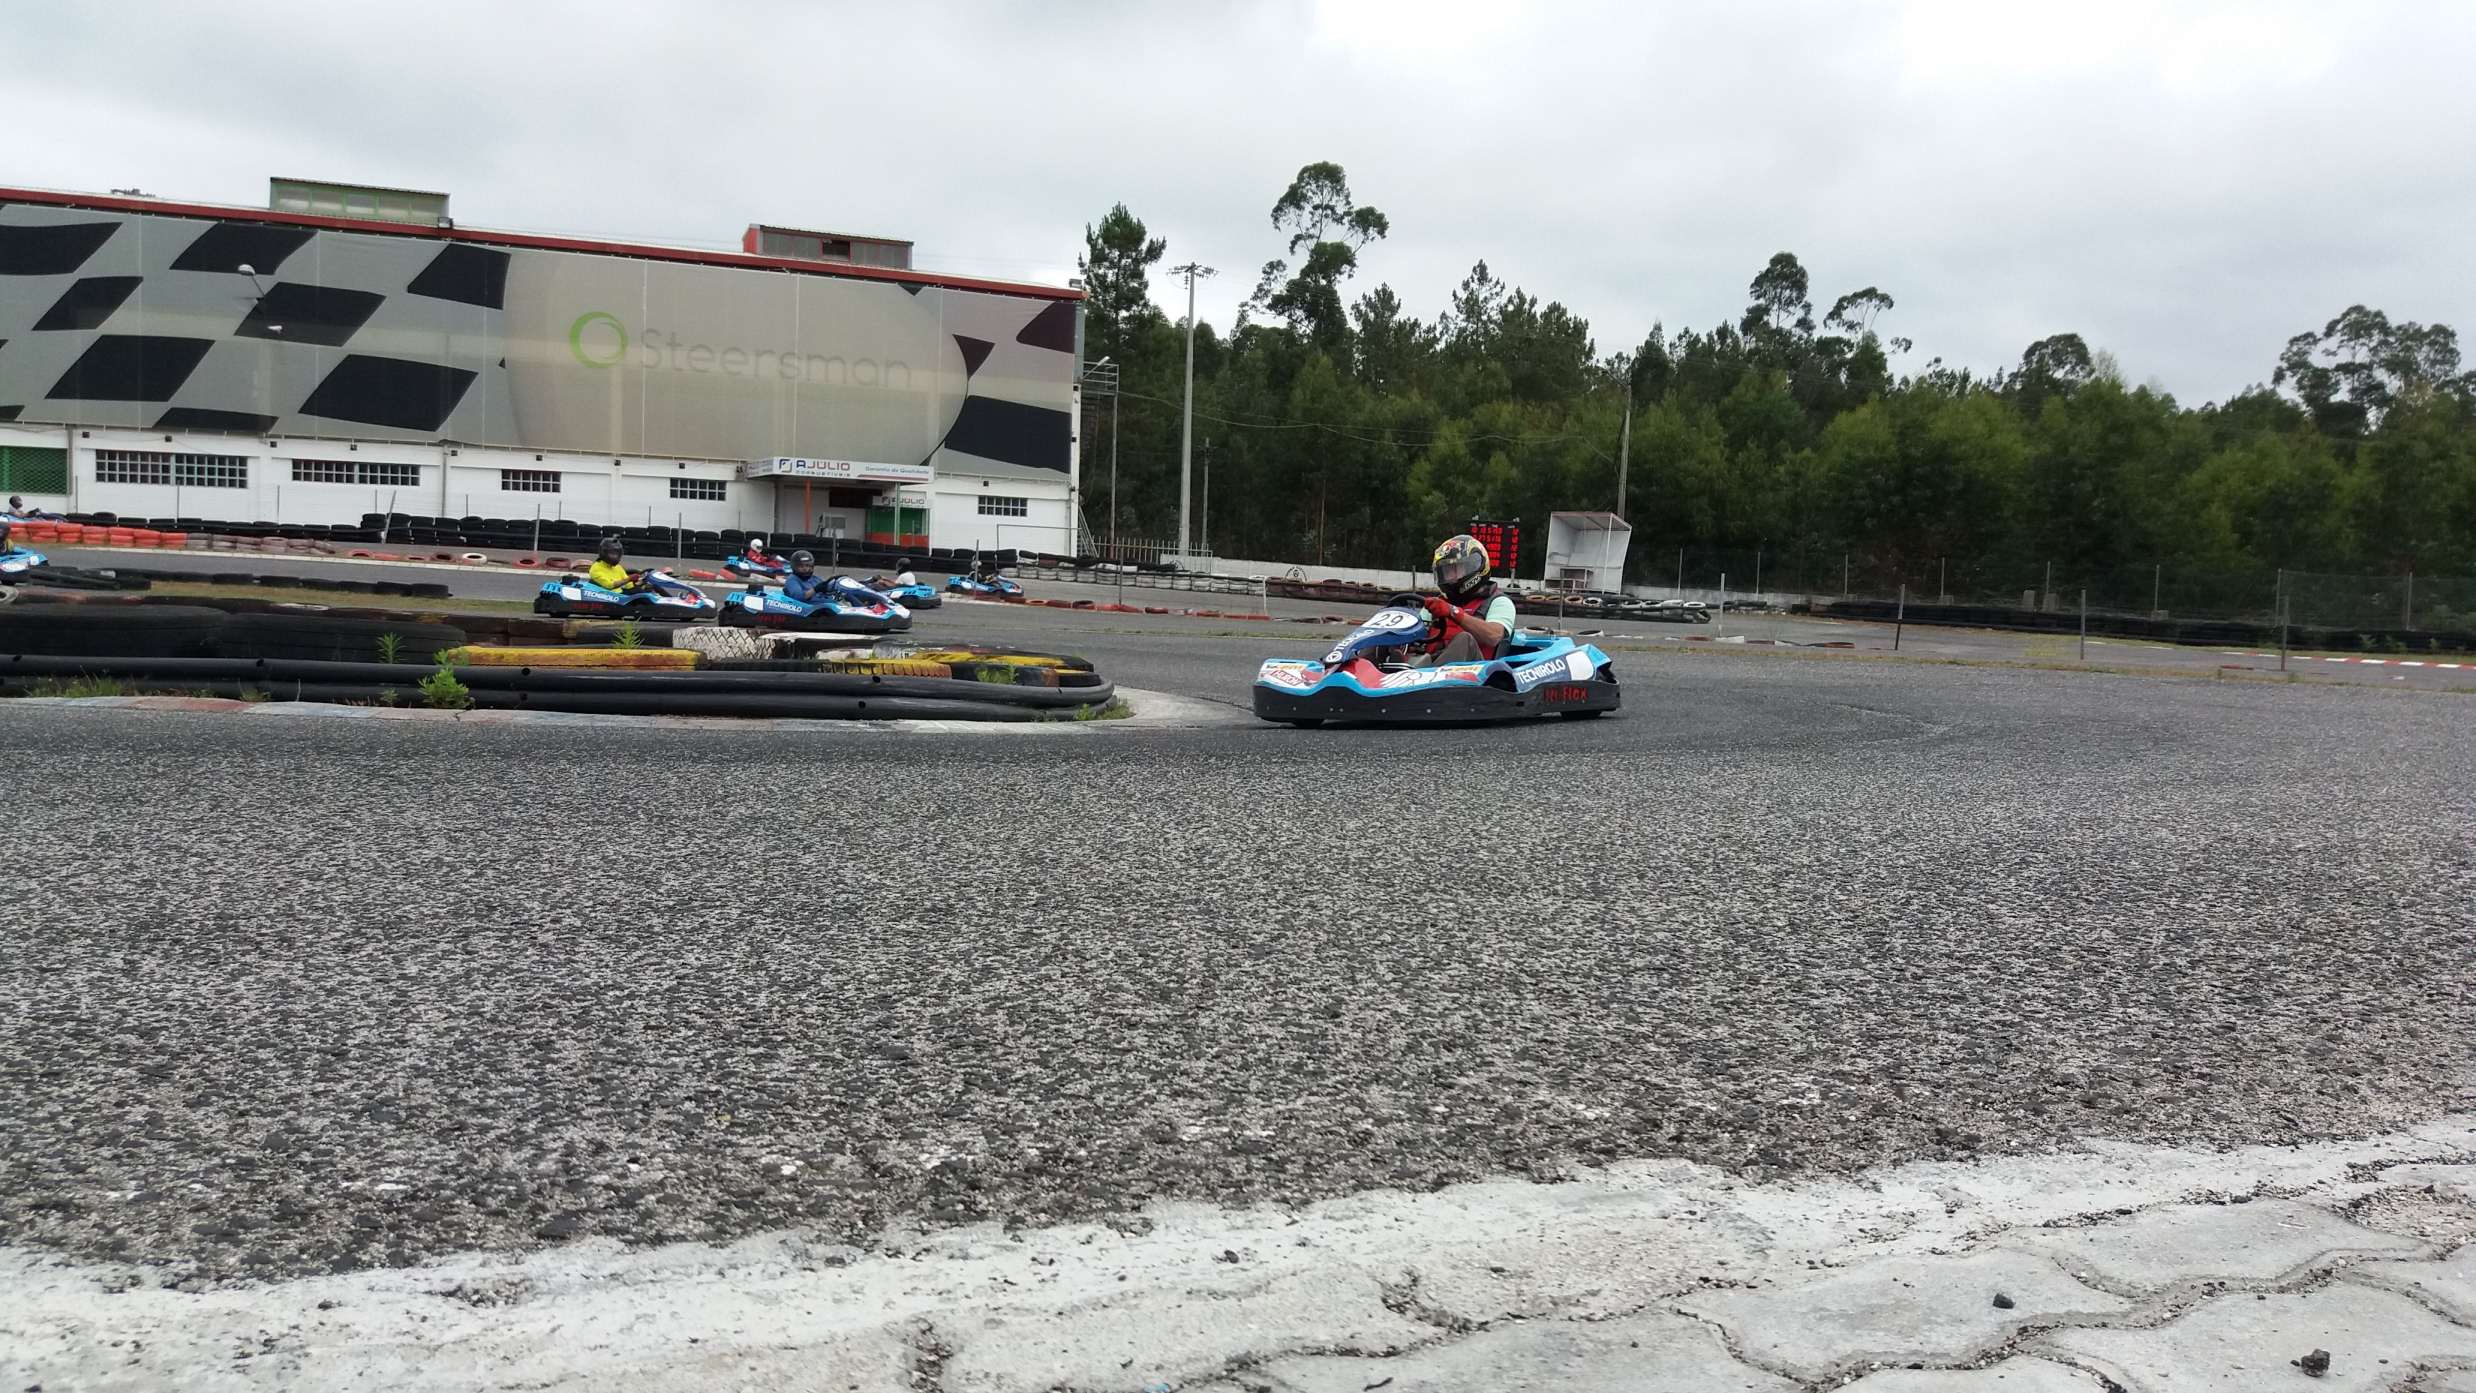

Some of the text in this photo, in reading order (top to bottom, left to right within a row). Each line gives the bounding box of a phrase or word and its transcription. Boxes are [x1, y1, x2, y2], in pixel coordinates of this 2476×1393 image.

[640, 327, 912, 388] Steersman
[1371, 613, 1404, 627] 29
[1517, 659, 1566, 685] TECNIROLO
